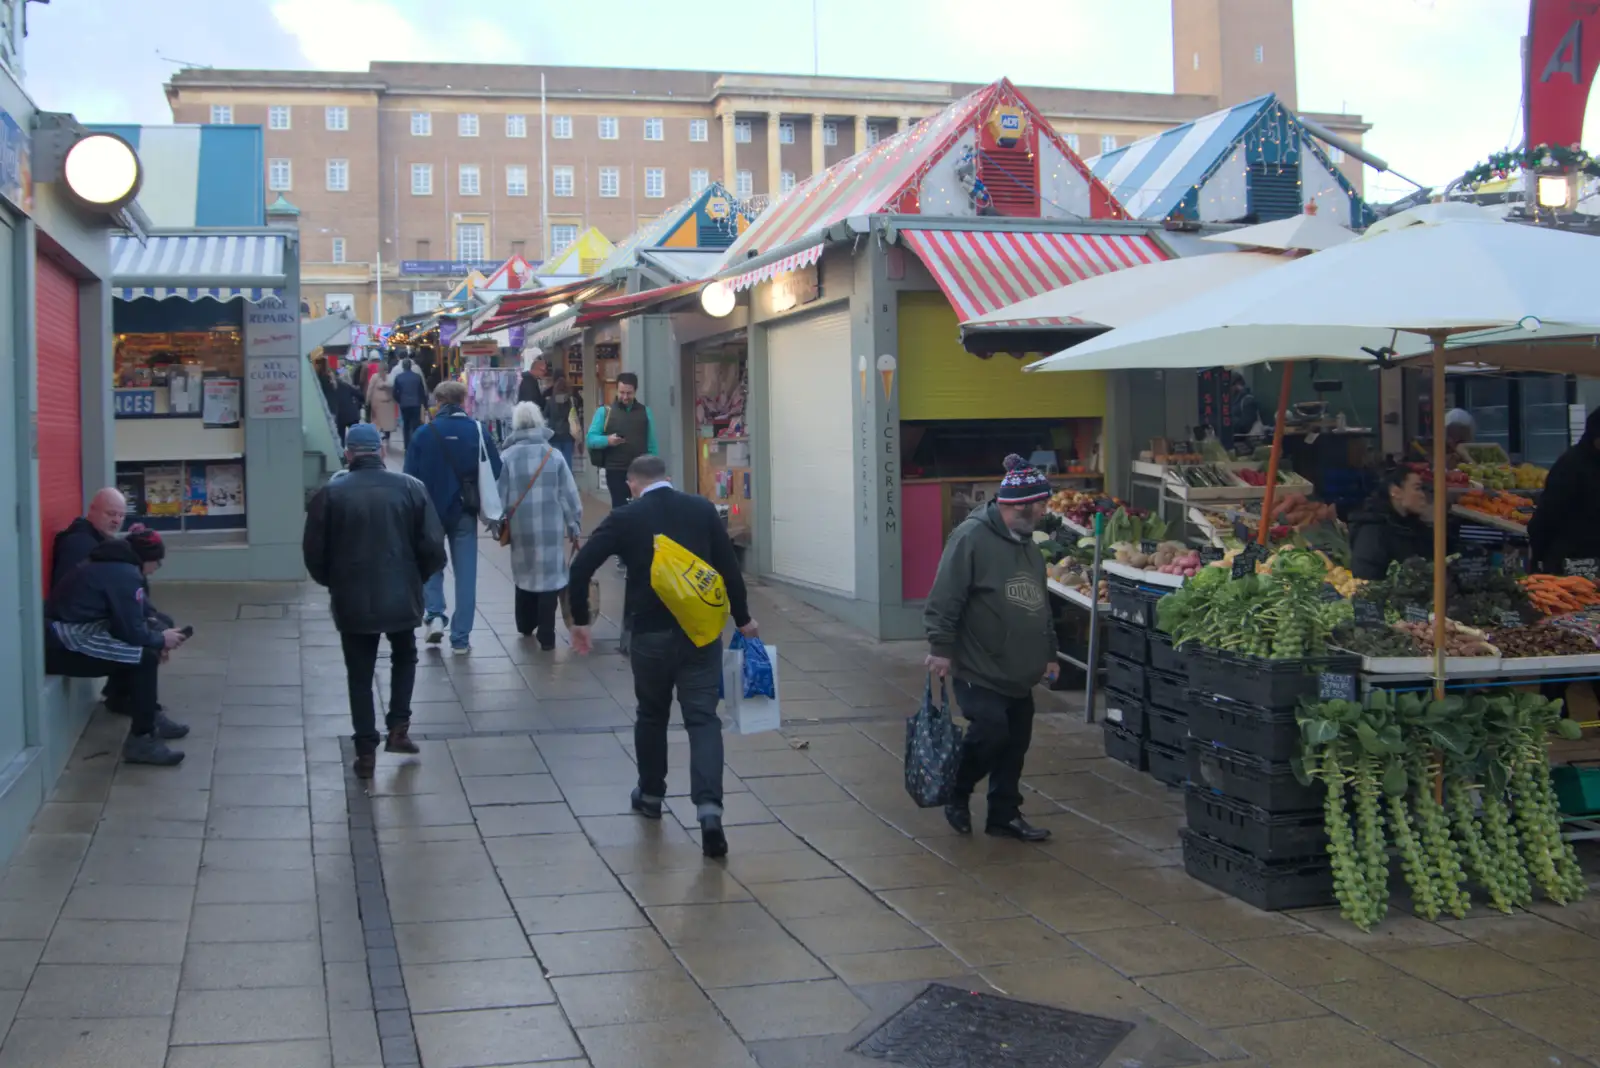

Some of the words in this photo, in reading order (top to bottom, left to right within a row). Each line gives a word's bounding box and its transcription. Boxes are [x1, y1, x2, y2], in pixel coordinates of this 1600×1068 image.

[248, 312, 296, 324] REPAIRS
[249, 370, 298, 381] CUTTING
[884, 461, 896, 533] CREAM
